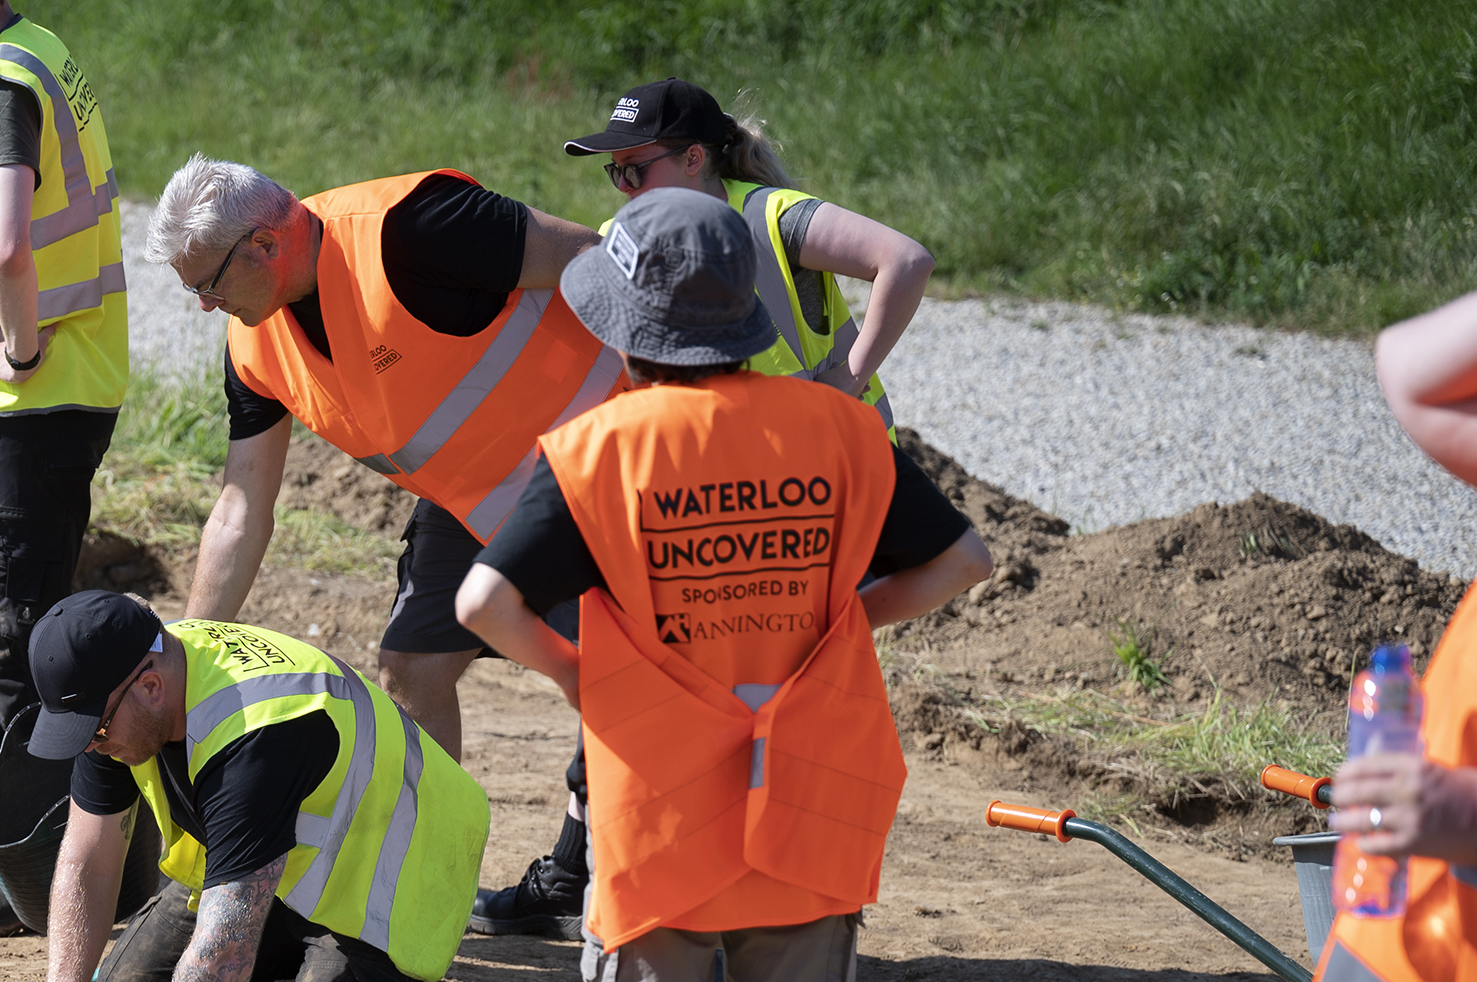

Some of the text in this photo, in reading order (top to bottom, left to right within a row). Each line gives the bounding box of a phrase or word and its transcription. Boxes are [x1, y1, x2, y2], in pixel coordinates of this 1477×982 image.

[653, 476, 832, 520] WATERLOO
[647, 527, 830, 569] UNCOVERED
[788, 579, 810, 596] BY
